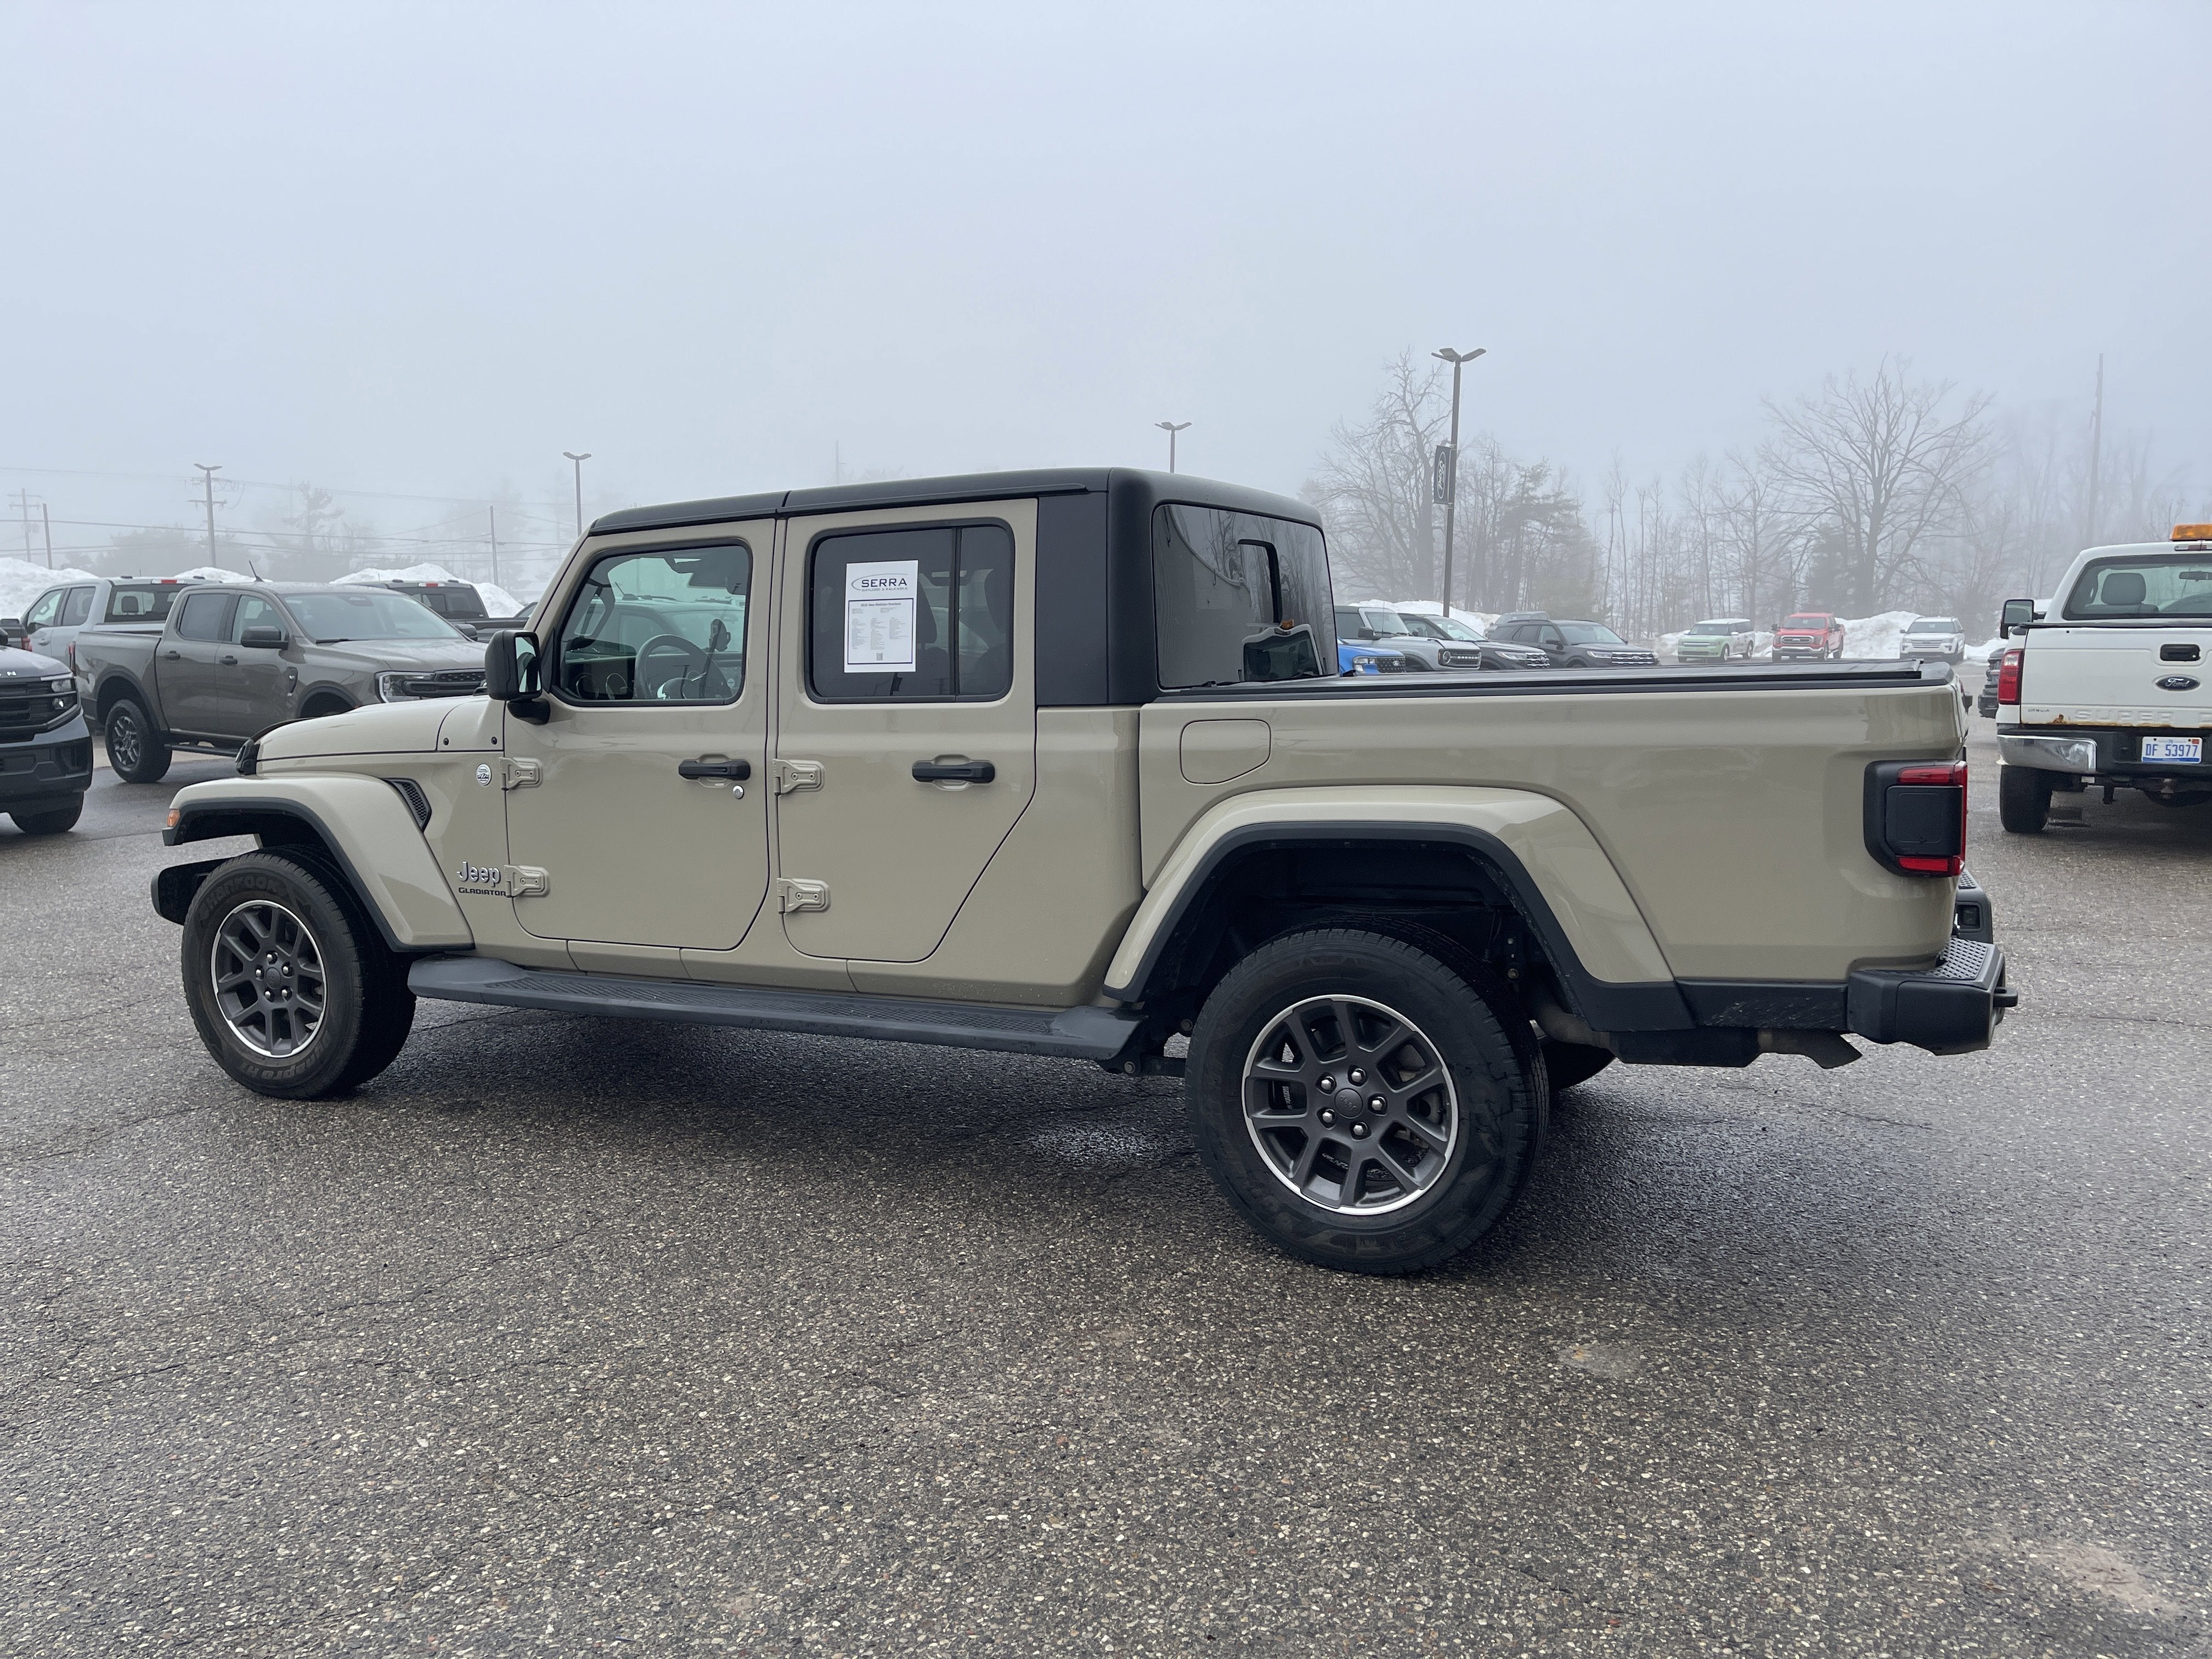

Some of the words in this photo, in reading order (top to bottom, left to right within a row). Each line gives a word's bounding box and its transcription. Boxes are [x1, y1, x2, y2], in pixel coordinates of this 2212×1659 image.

[861, 578, 907, 588] SERRA
[2165, 678, 2190, 687] Ford
[2145, 743, 2159, 756] DF
[2165, 744, 2198, 757] 53977
[456, 861, 501, 888] Jeep
[458, 887, 506, 896] GLADIATOR
